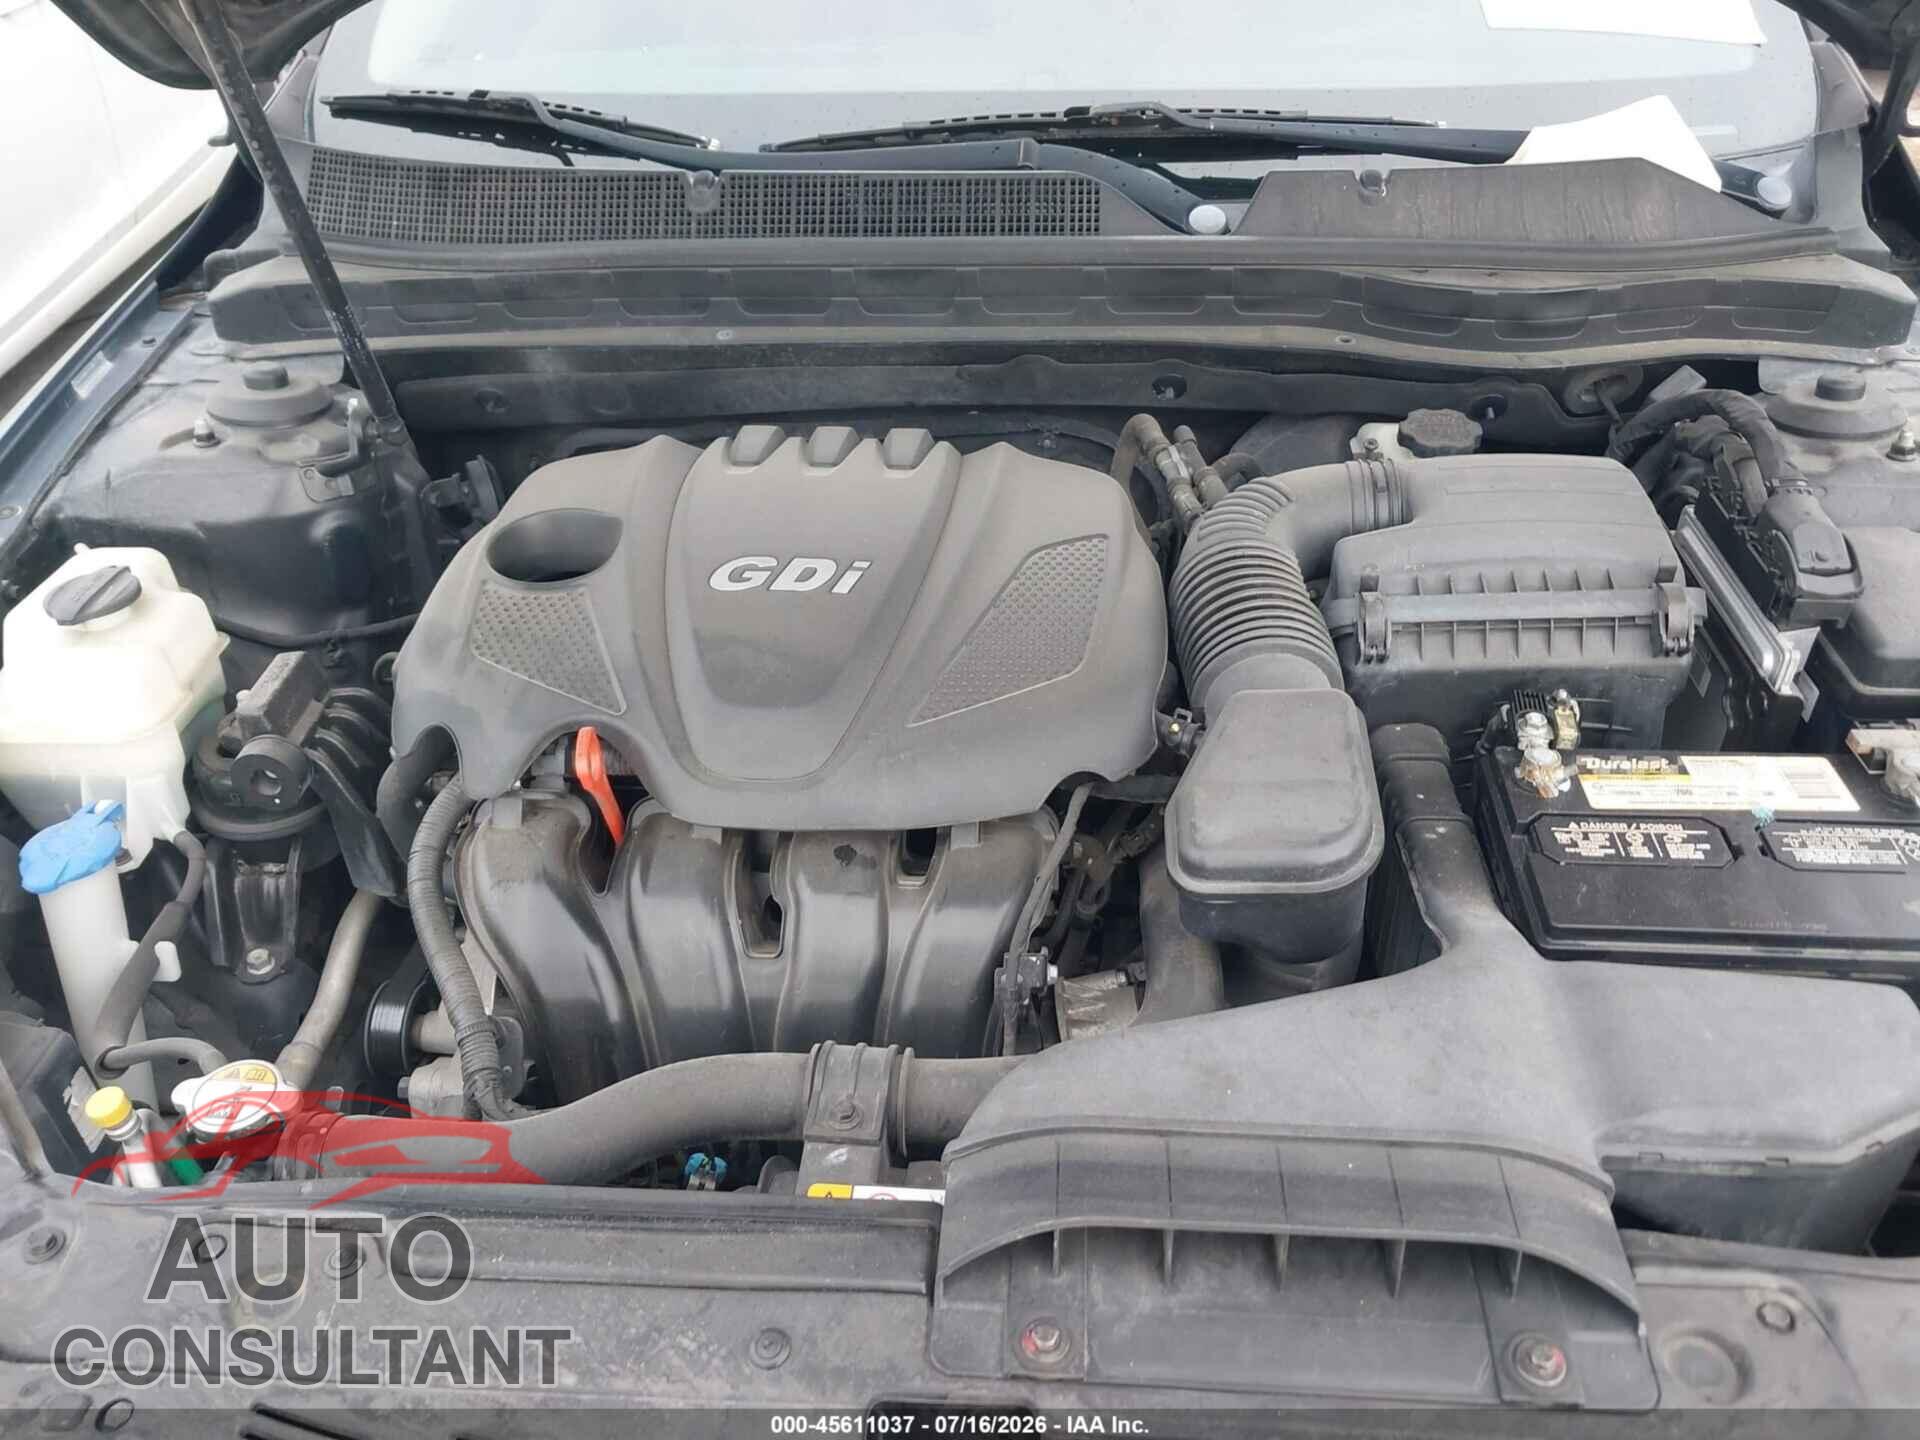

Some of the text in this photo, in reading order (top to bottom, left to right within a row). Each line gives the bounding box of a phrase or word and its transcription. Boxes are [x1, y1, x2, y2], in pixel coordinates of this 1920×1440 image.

[709, 555, 872, 594] GDi
[1580, 757, 1669, 770] Duralast
[1581, 822, 1628, 832] DANGER
[1640, 823, 1683, 833] POISON
